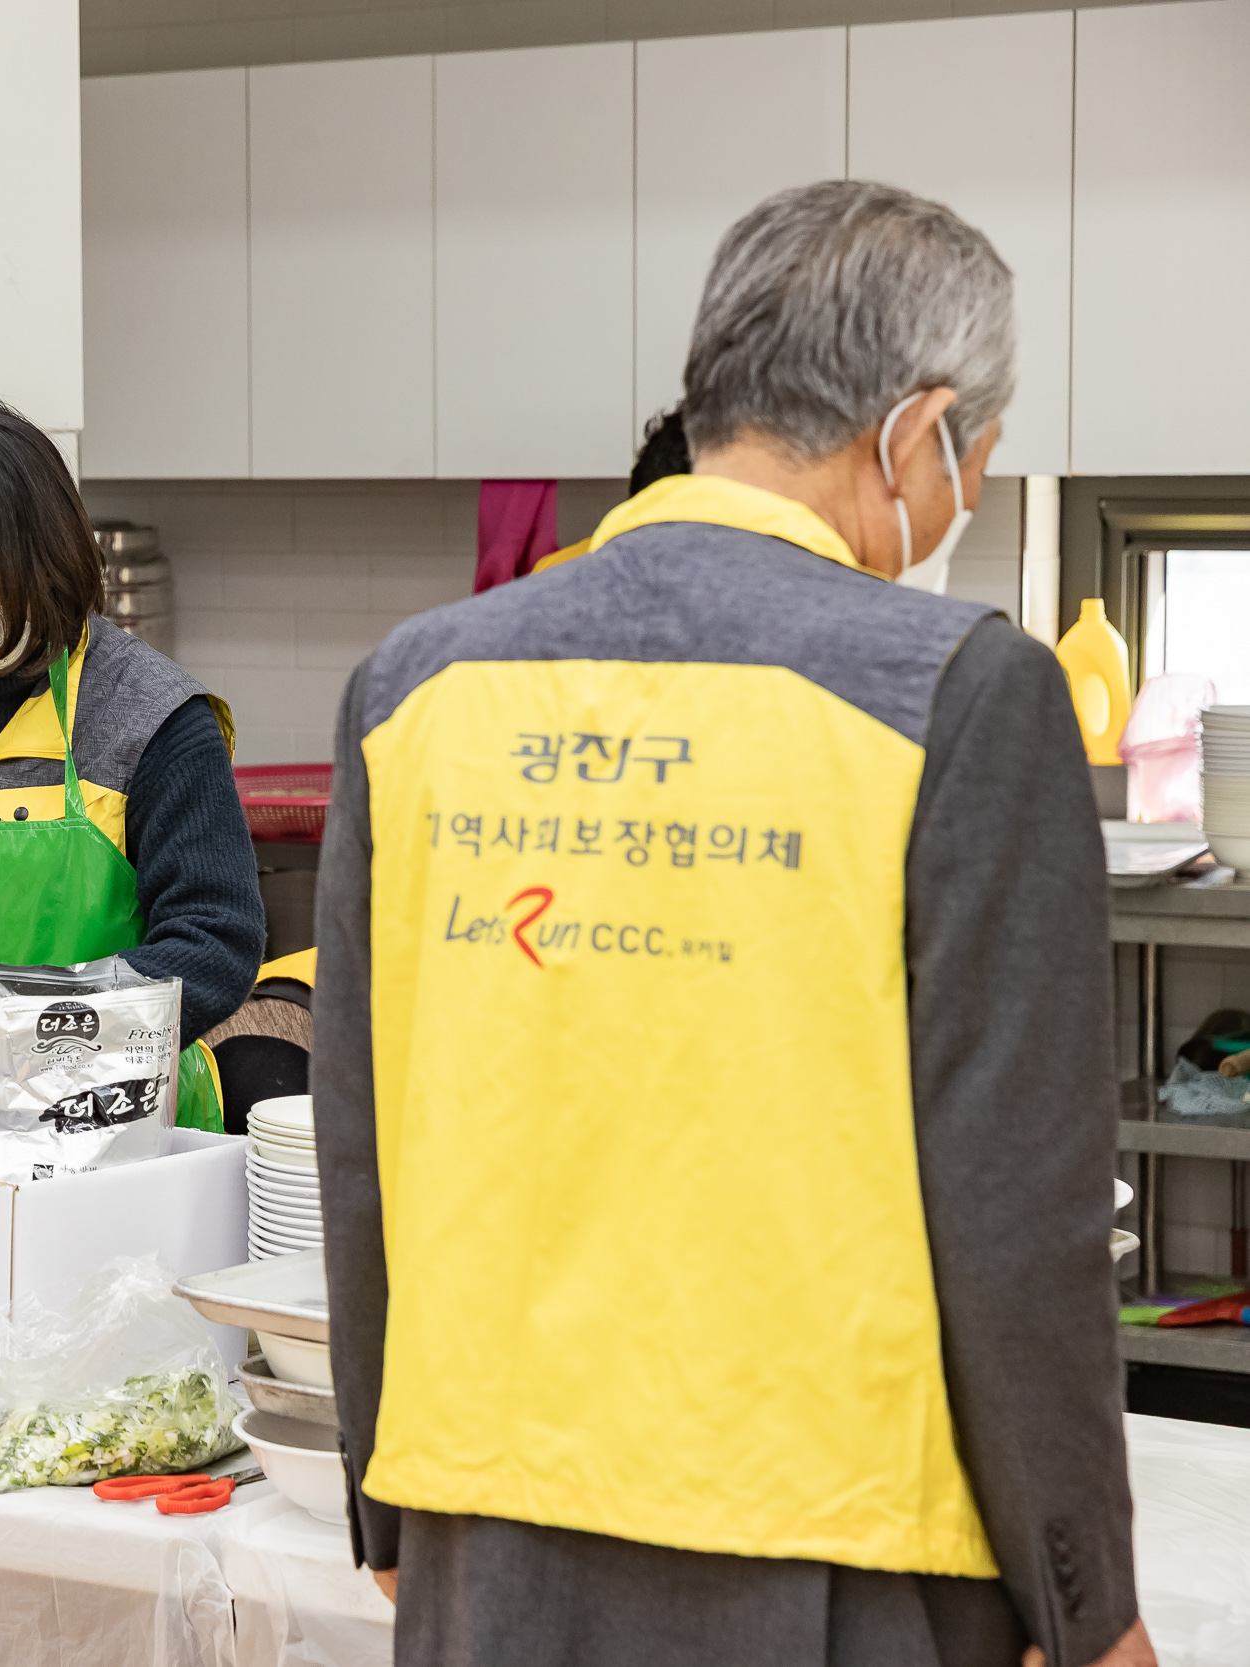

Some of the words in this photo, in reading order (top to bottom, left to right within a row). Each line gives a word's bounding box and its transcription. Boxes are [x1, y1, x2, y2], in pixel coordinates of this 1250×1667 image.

[510, 732, 694, 783] 광진구
[40, 1014, 96, 1033] 더조은
[60, 1081, 158, 1119] 더조은
